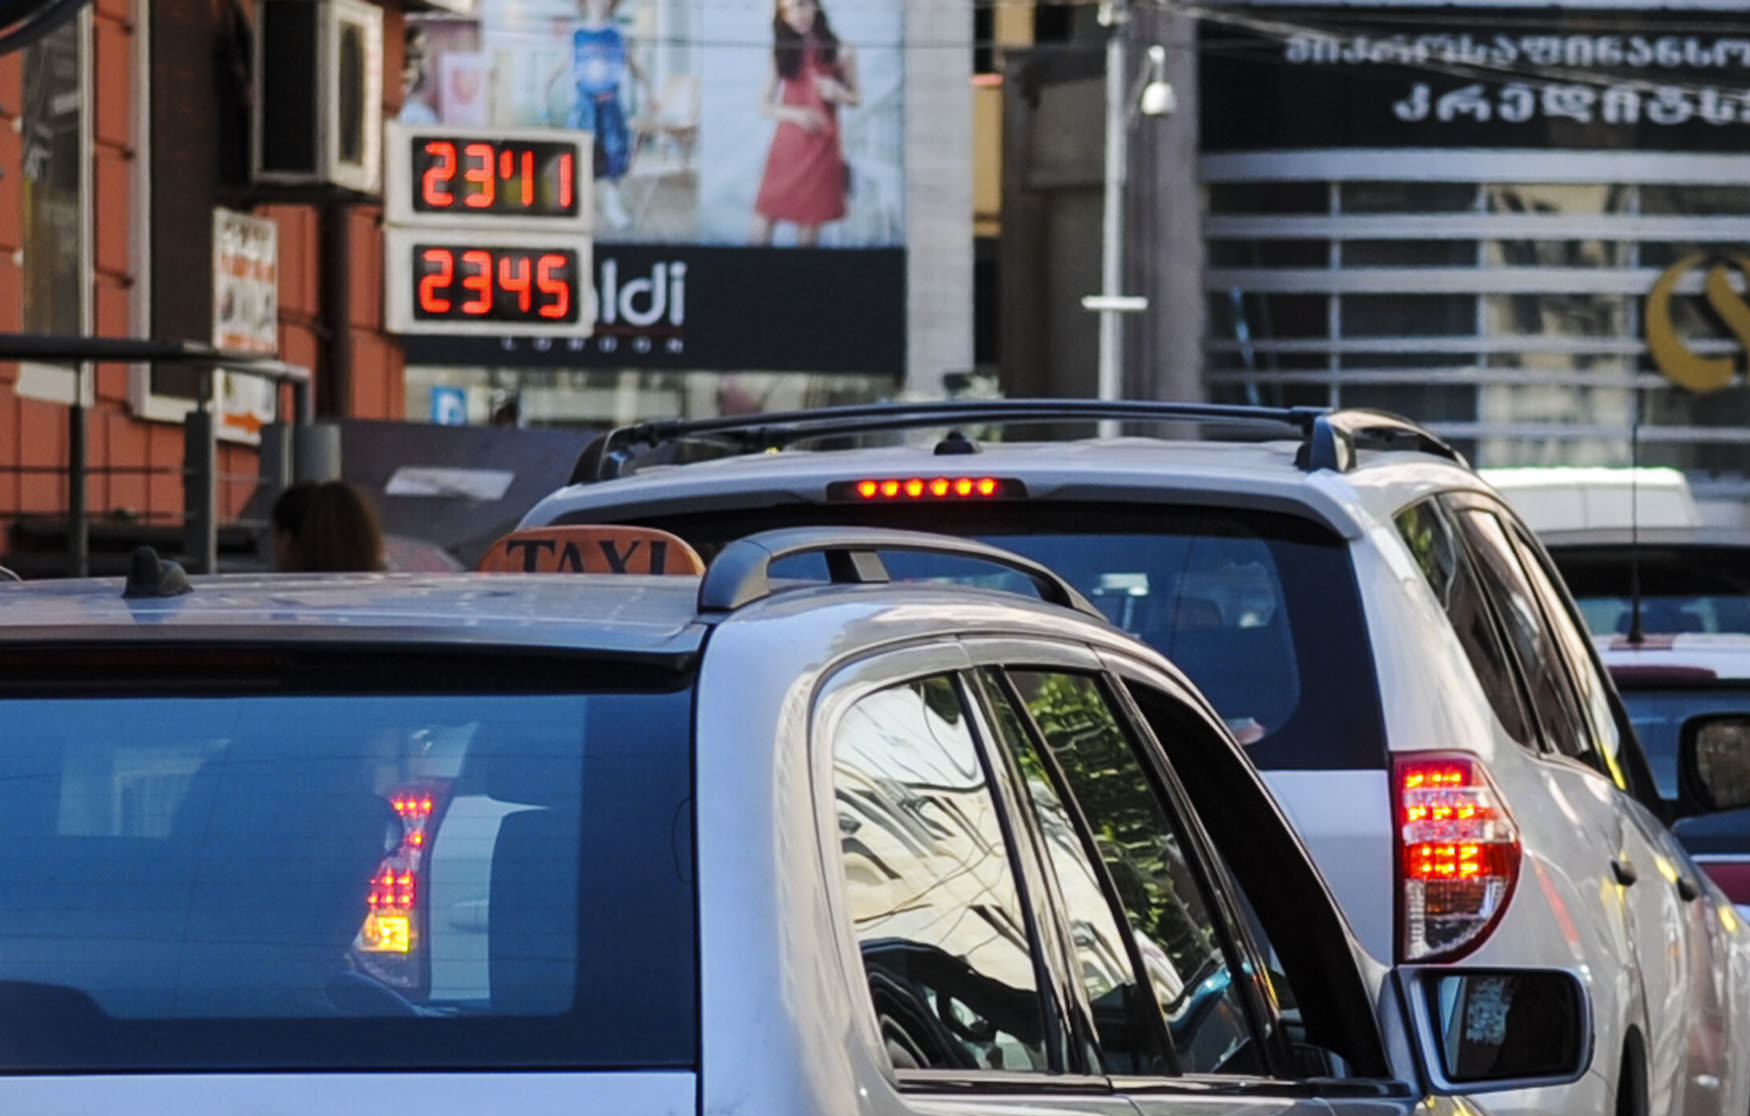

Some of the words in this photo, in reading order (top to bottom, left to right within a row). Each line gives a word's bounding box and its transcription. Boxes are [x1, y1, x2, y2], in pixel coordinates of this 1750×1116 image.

[419, 249, 570, 319] 2345
[594, 258, 687, 327] ldi
[506, 539, 669, 575] TAXI
